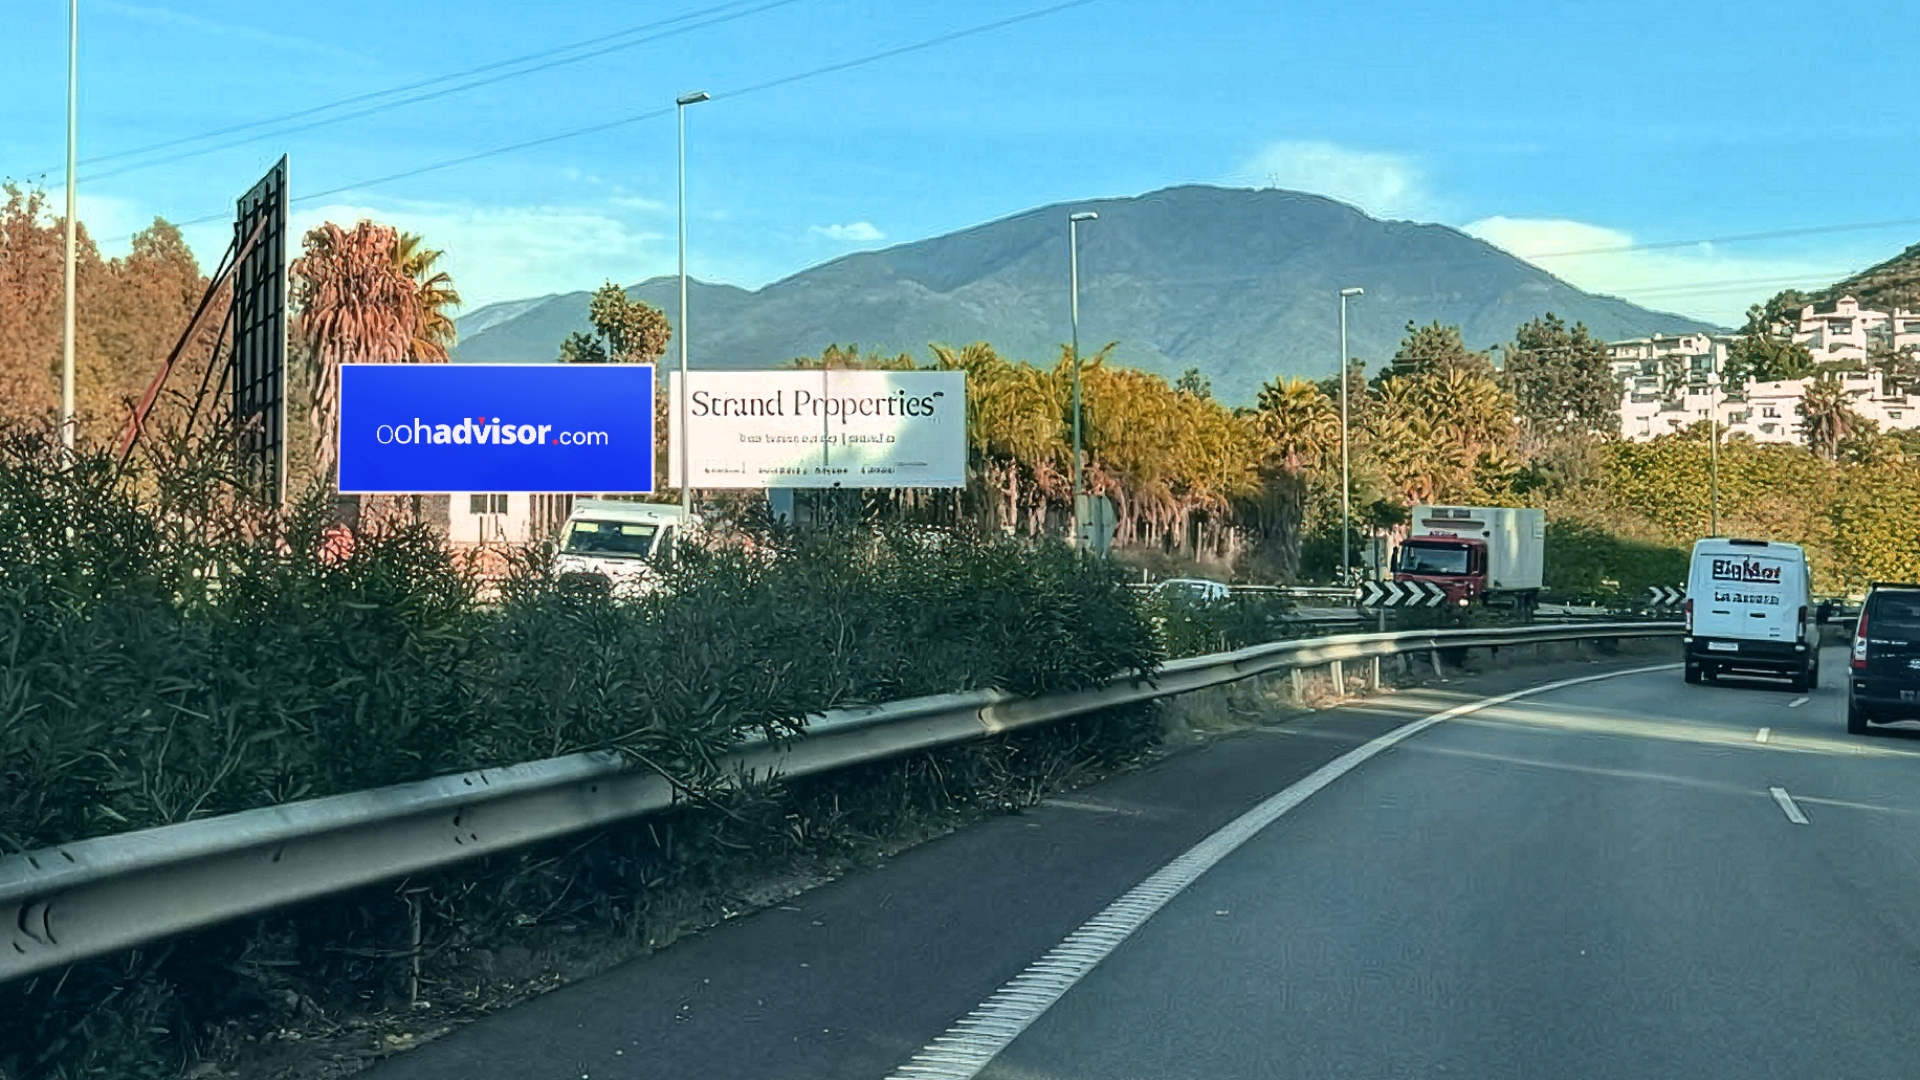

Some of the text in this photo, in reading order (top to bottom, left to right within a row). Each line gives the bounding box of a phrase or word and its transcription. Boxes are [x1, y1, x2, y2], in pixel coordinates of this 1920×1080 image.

[691, 389, 936, 424] Strand Properties
[376, 417, 609, 446] oohadvisor.com
